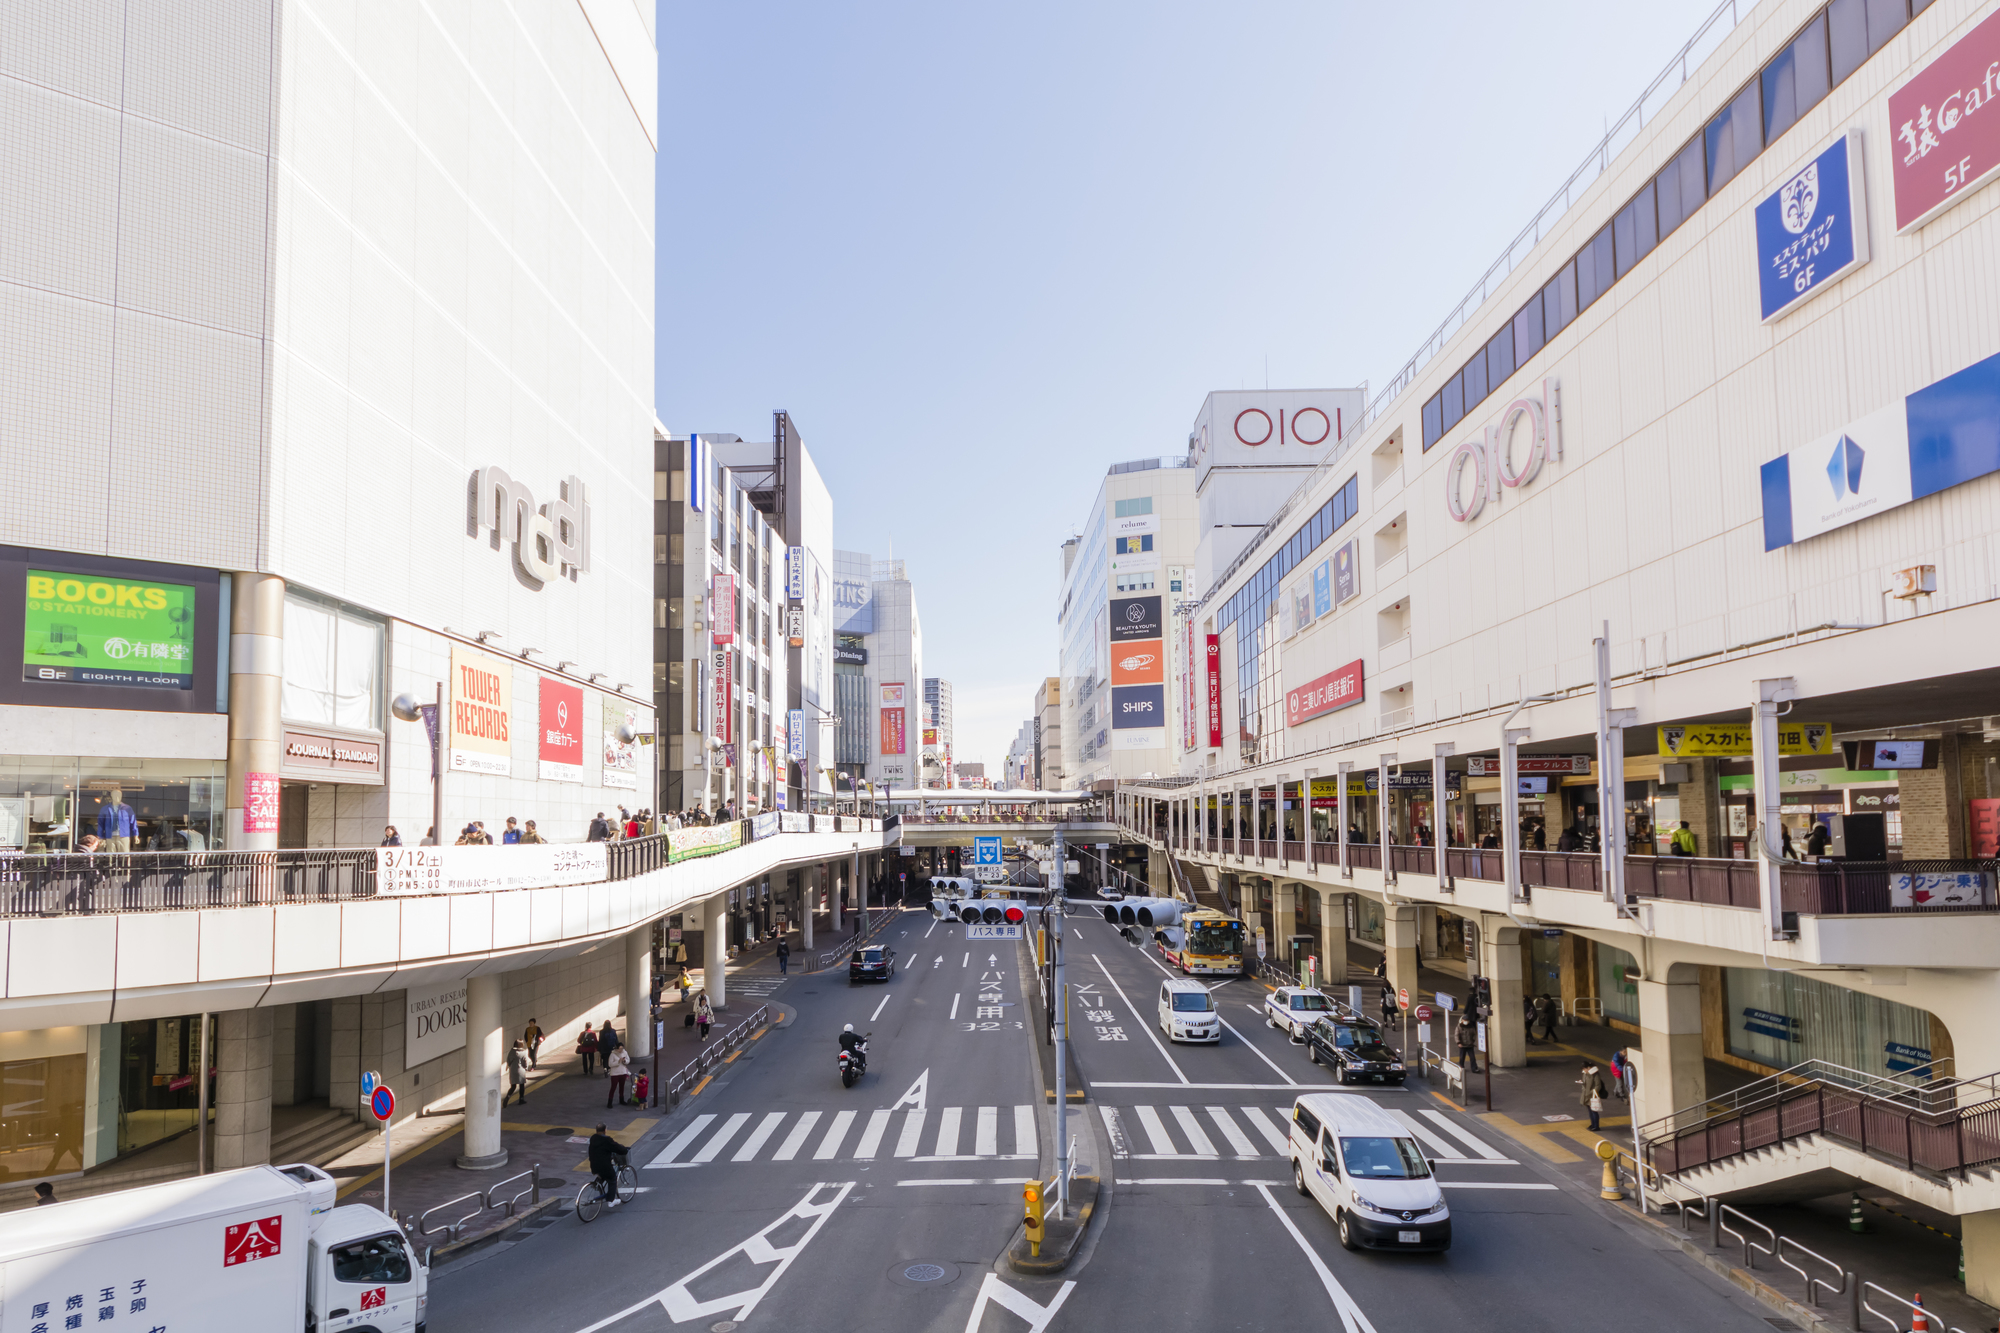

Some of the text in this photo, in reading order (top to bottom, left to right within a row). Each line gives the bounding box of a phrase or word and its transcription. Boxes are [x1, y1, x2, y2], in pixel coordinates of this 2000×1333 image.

[1898, 105, 1940, 163] 猿
[1906, 153, 1921, 167] saru
[1944, 155, 1972, 194] 5F
[1773, 214, 1835, 267] エステティック
[1779, 232, 1830, 279] ミス・パリ
[1794, 263, 1816, 293] 6F
[1821, 512, 1837, 523] Bank
[1844, 497, 1877, 514] Yokohama
[474, 465, 592, 585] modi
[29, 576, 168, 610] BOOKS
[43, 602, 148, 620] STATIONERY
[131, 642, 189, 660] 有隣堂
[840, 652, 863, 661] Dining
[38, 668, 67, 679] 8F
[82, 673, 180, 684] EIGHTH FLOOR
[460, 664, 500, 707] TOWER
[1302, 674, 1355, 712] 三菱UFJ信託銀行
[1123, 701, 1153, 713] SHIPS
[1210, 671, 1218, 731] 三菱UFJ信託銀行
[456, 700, 508, 742] RECORDS
[546, 729, 578, 747] 銀座カラー
[289, 743, 378, 763] JOURNAL STANDARD
[250, 806, 278, 818] SALE
[385, 850, 443, 868] 3/12(土)
[448, 877, 502, 888] 町田市民ホール
[1898, 874, 1989, 890] タクシー乗場
[974, 927, 1016, 936] バス専用
[411, 997, 436, 1014] URBAN
[1896, 1046, 1910, 1055] Bank
[245, 1250, 262, 1262] 富士
[31, 1279, 147, 1320] 厚焼玉子
[31, 1297, 147, 1333] 各種鶏卵
